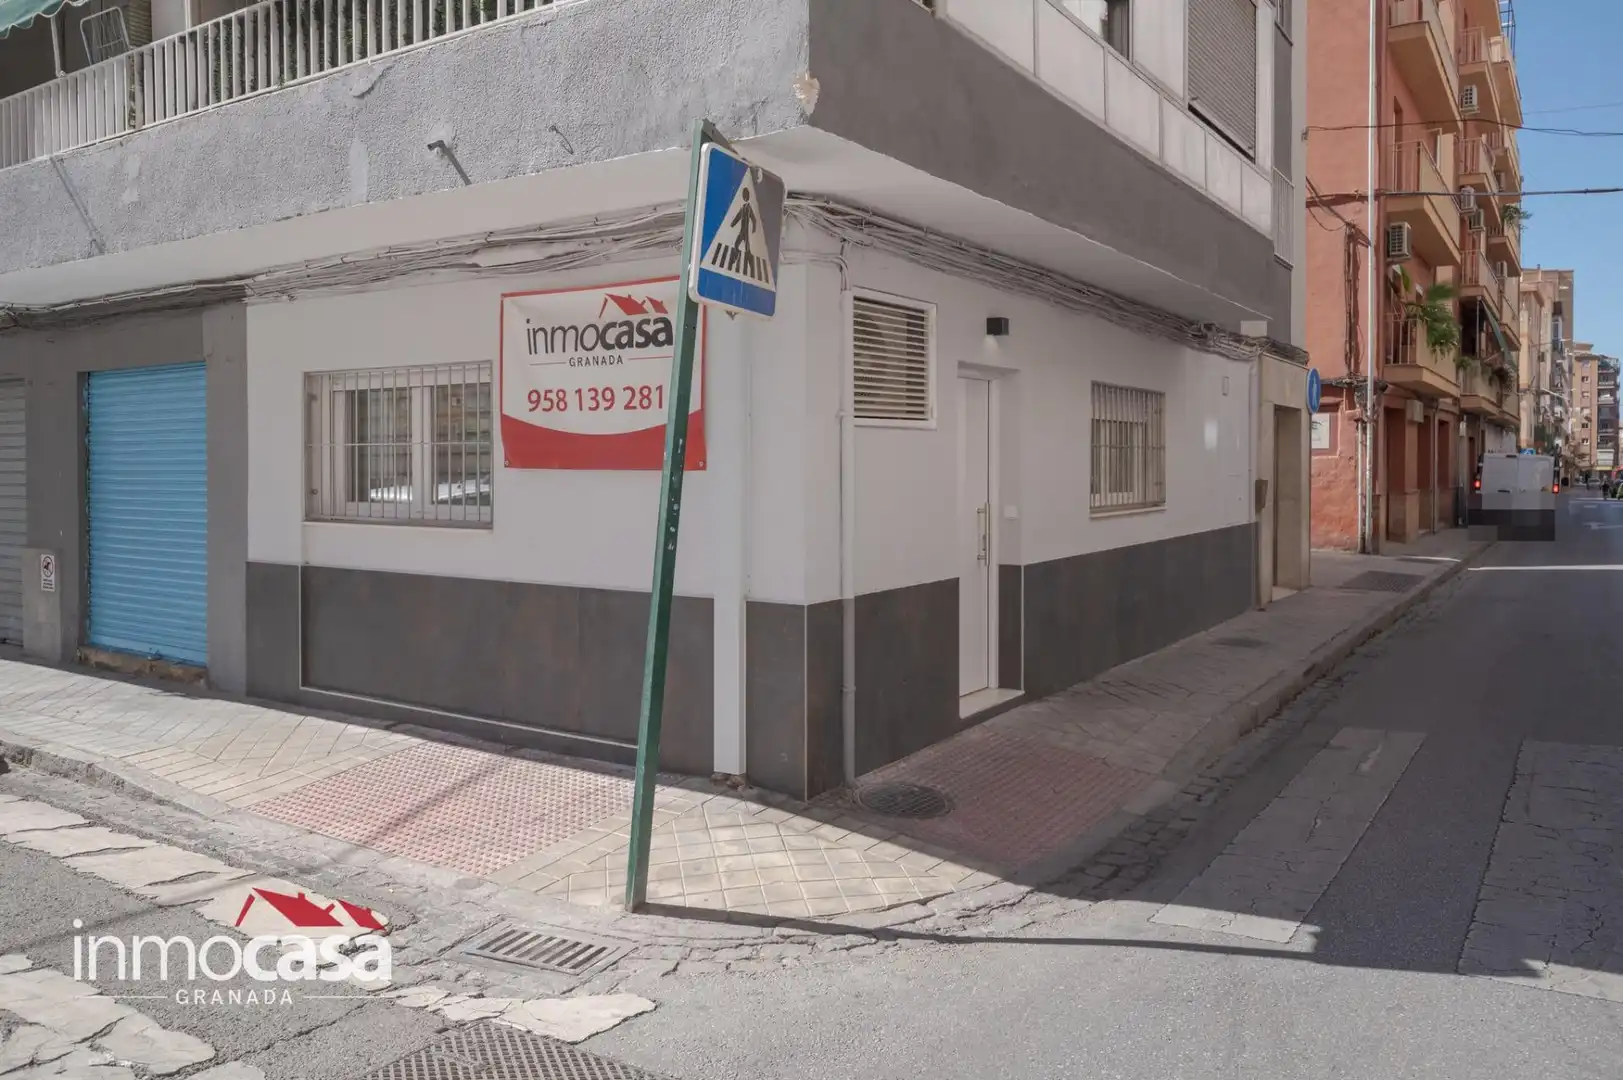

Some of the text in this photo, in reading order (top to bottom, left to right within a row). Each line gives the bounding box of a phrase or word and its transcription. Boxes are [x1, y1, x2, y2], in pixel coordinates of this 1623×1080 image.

[526, 317, 673, 355] inmocasa
[569, 355, 624, 367] GRANADA
[527, 385, 664, 412] 958 139 281
